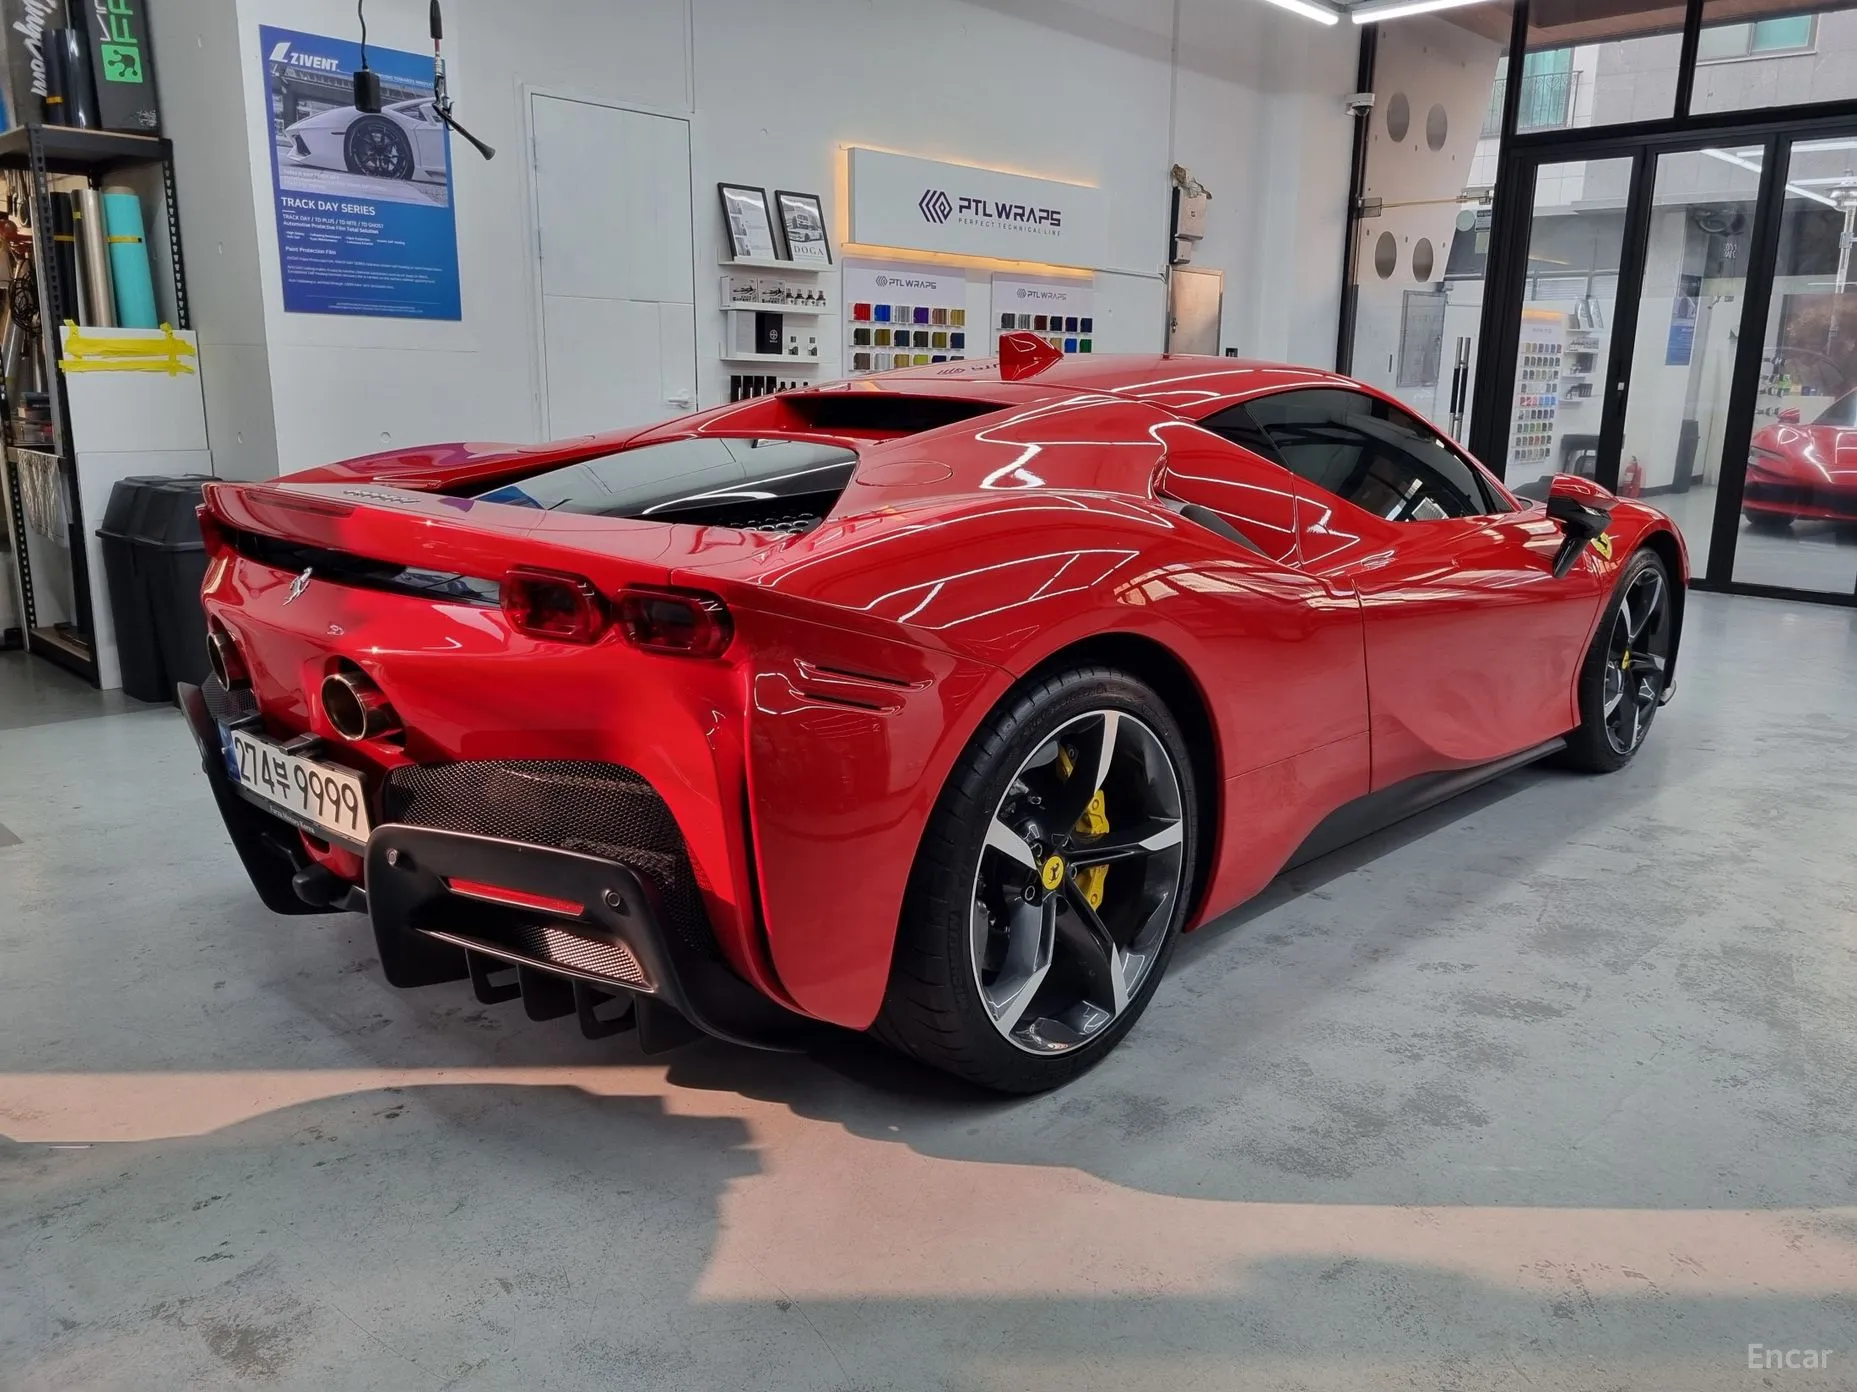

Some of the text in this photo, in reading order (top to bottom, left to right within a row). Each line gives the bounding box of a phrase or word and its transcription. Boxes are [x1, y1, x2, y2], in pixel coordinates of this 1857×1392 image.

[289, 52, 338, 71] ZIVENT
[281, 197, 376, 216] TRACK DAY SERIES
[282, 213, 300, 221] TRACK
[958, 217, 1061, 237] PERFECT TECHNICAL LINE
[793, 245, 824, 256] DOGA
